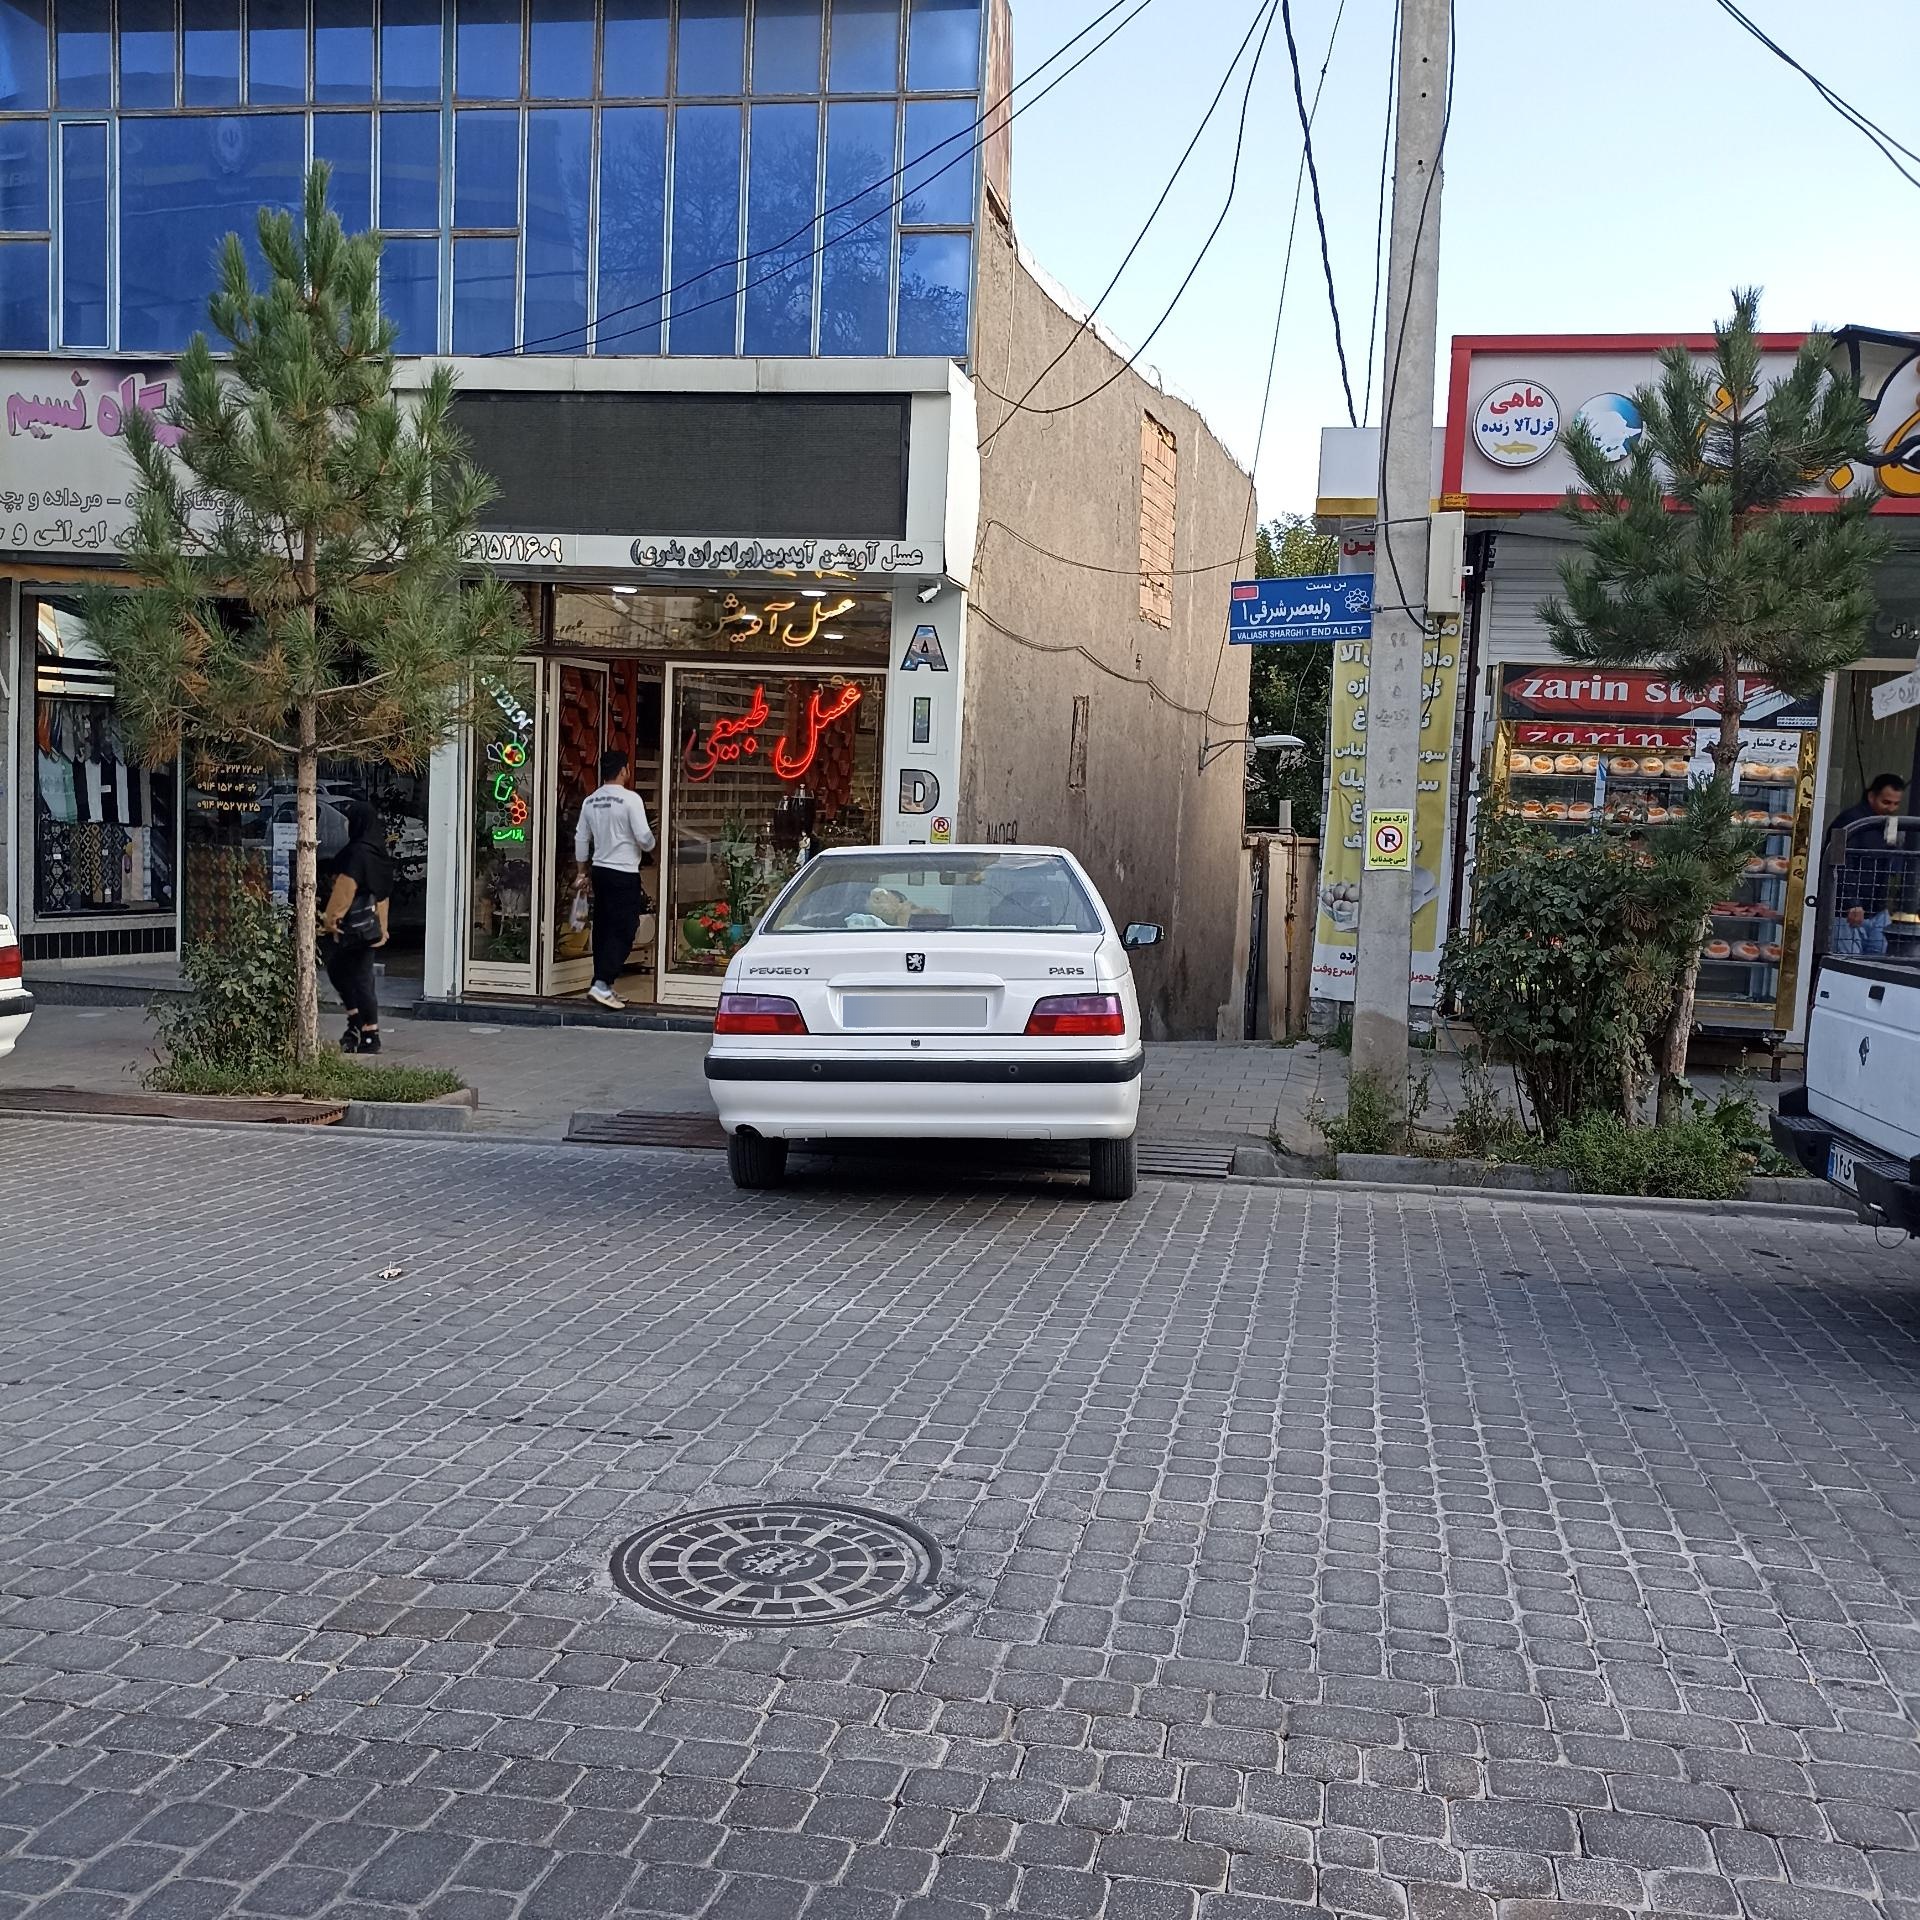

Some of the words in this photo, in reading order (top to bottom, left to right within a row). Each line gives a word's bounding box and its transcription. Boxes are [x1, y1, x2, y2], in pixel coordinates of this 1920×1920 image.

[7, 369, 88, 440] نسیم
[1490, 387, 1543, 414] ماهی
[1481, 420, 1510, 436] زنده
[28, 493, 38, 511] و
[43, 488, 102, 512] مردانه
[12, 523, 28, 546] و
[34, 519, 107, 548] ایرانی
[819, 541, 880, 570] آویشن
[881, 543, 924, 571] عسل
[1305, 582, 1332, 593] بست
[1333, 581, 1347, 592] بن
[782, 598, 857, 647] عسل
[1237, 630, 1268, 640] VALIASR
[1269, 629, 1304, 638] SHARGHI
[1311, 627, 1331, 636] END
[1332, 625, 1364, 635] ALLEY
[1522, 675, 1629, 701] zarin
[684, 684, 769, 781] طبیعی
[776, 686, 861, 779] عسل
[1526, 728, 1669, 747] zarin
[1751, 738, 1777, 749] کشتار
[1779, 739, 1798, 751] مرغ
[749, 966, 811, 976] PEUGEOT
[1048, 966, 1085, 976] PARS
